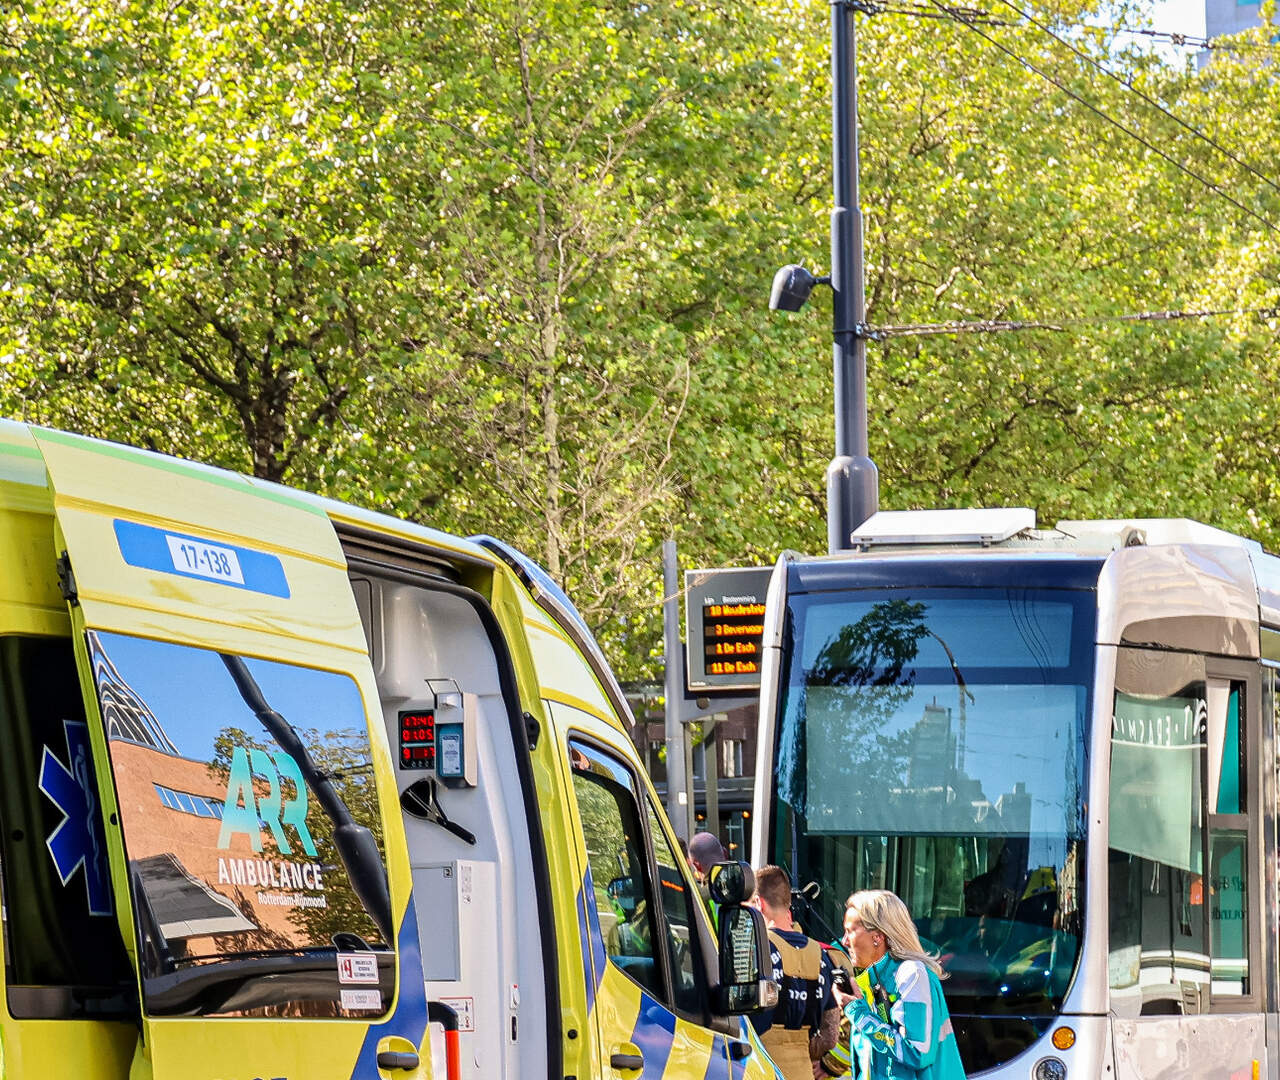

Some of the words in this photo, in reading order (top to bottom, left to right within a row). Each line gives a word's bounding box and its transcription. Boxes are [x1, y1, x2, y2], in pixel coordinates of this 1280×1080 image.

[181, 543, 231, 576] 17-138
[723, 643, 735, 654] De
[736, 641, 756, 654] Esch
[712, 662, 723, 674] 11
[724, 662, 735, 674] De
[736, 661, 757, 674] Esch
[218, 858, 325, 891] AMBULANCE
[258, 891, 327, 910] Rotterdam-Rijnmond
